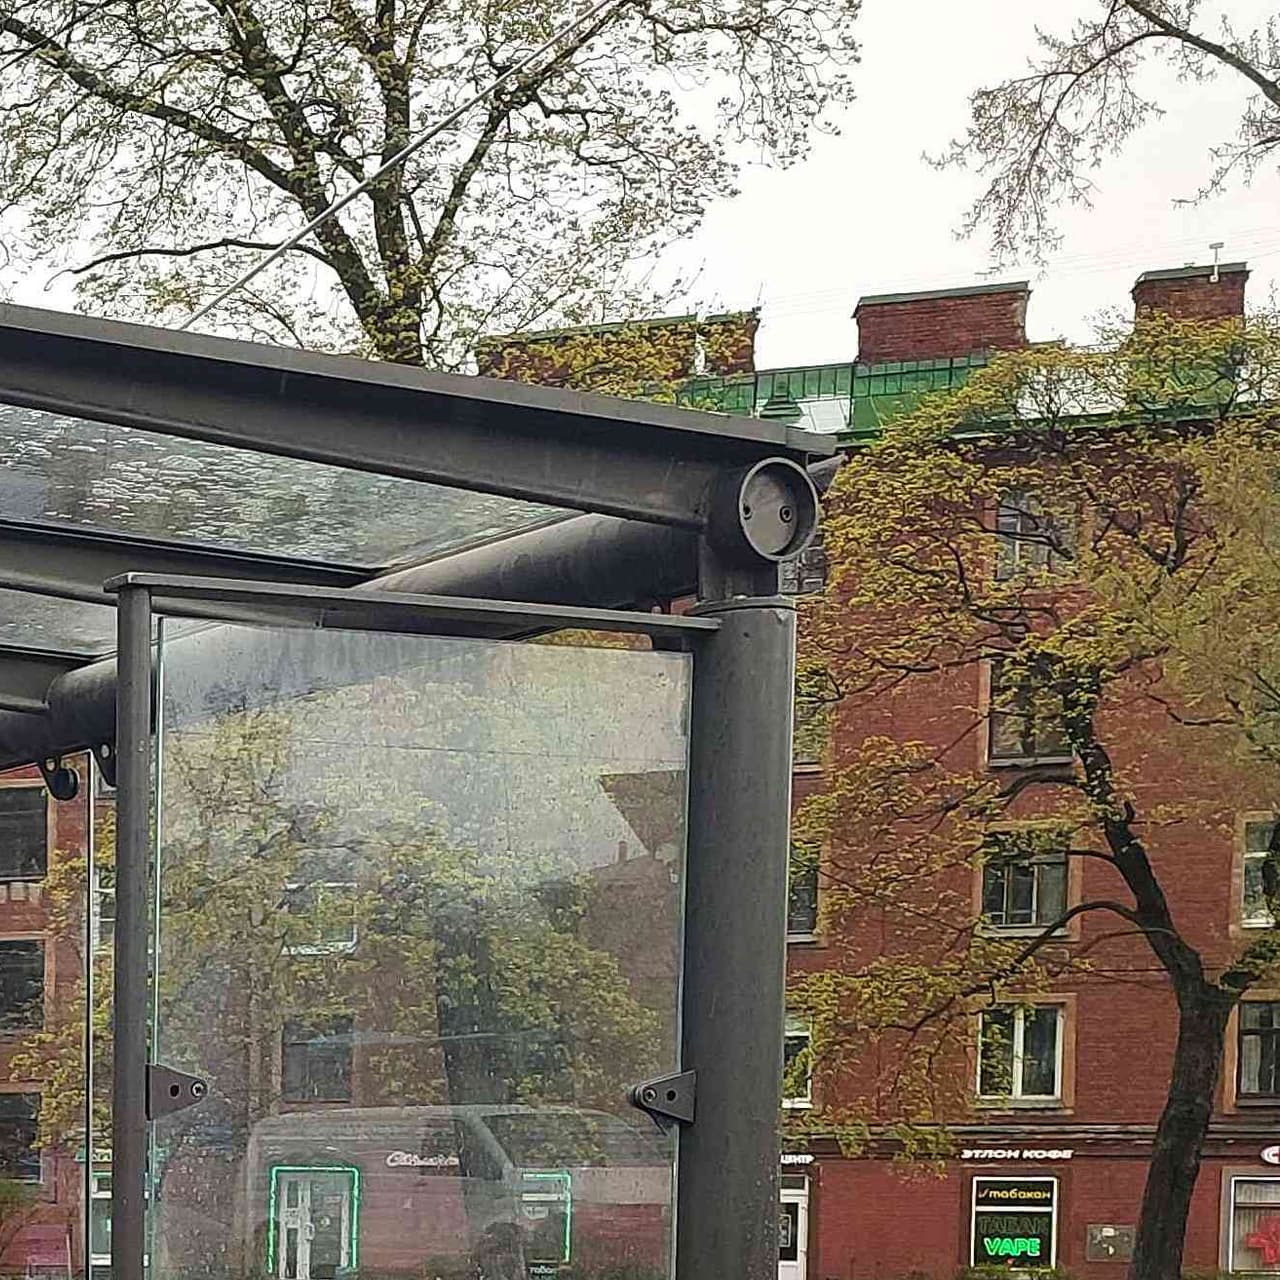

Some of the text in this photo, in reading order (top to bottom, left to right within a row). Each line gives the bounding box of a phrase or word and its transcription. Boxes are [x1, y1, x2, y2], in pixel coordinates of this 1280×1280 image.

[960, 1149, 1075, 1159] ЭТЛОН КОФЕ
[983, 1237, 1041, 1257] VAPE
